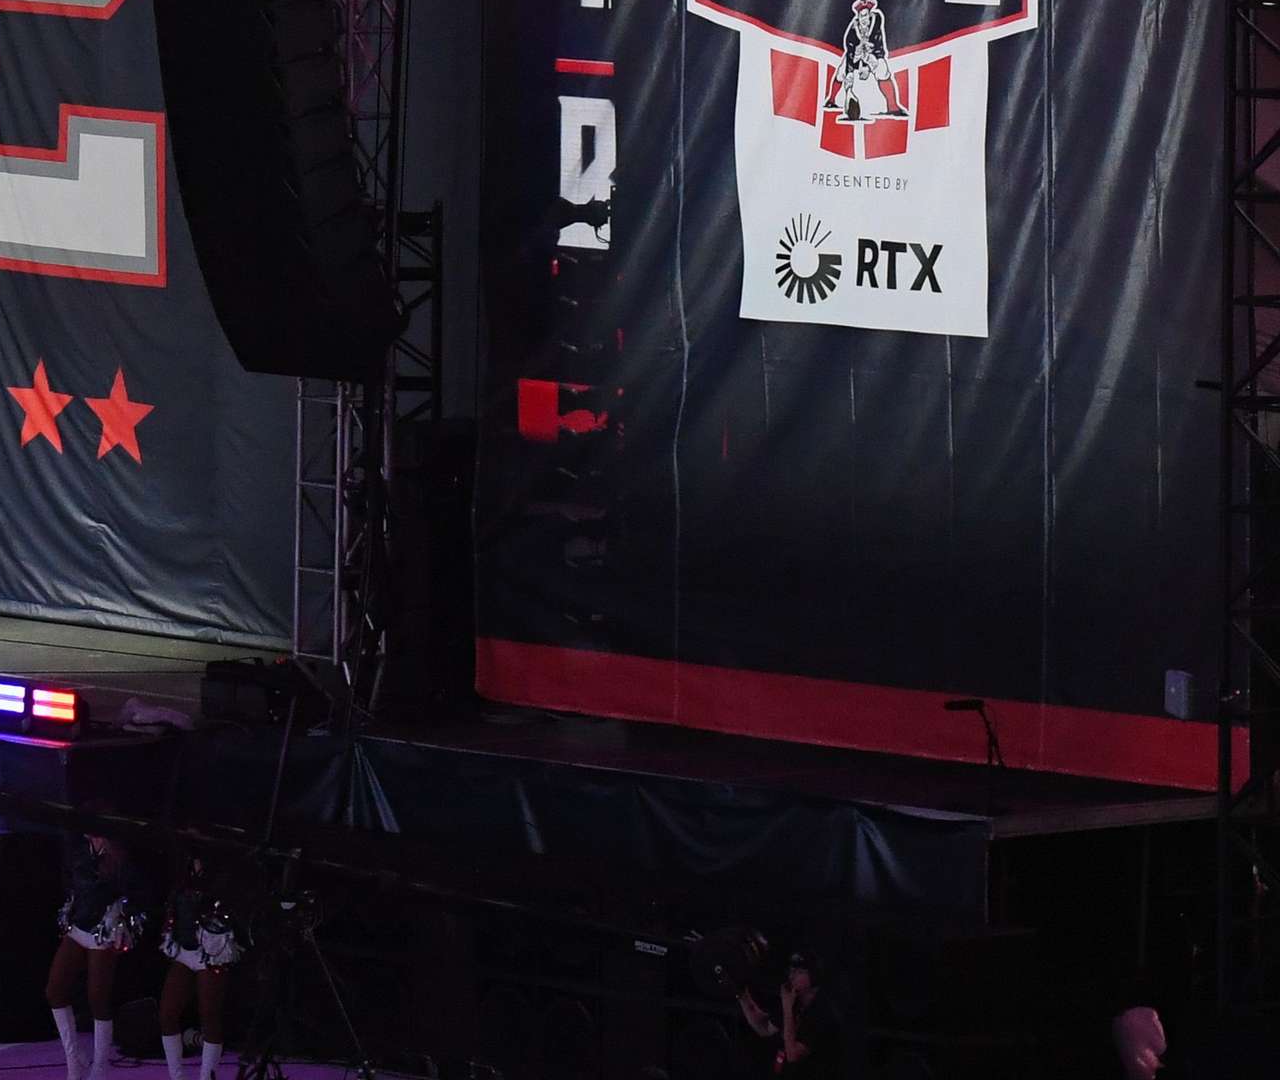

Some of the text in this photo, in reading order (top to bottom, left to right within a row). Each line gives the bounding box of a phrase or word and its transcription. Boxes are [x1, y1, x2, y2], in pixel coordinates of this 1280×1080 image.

[812, 172, 909, 191] PRESENTED BY
[856, 238, 944, 294] RTX
